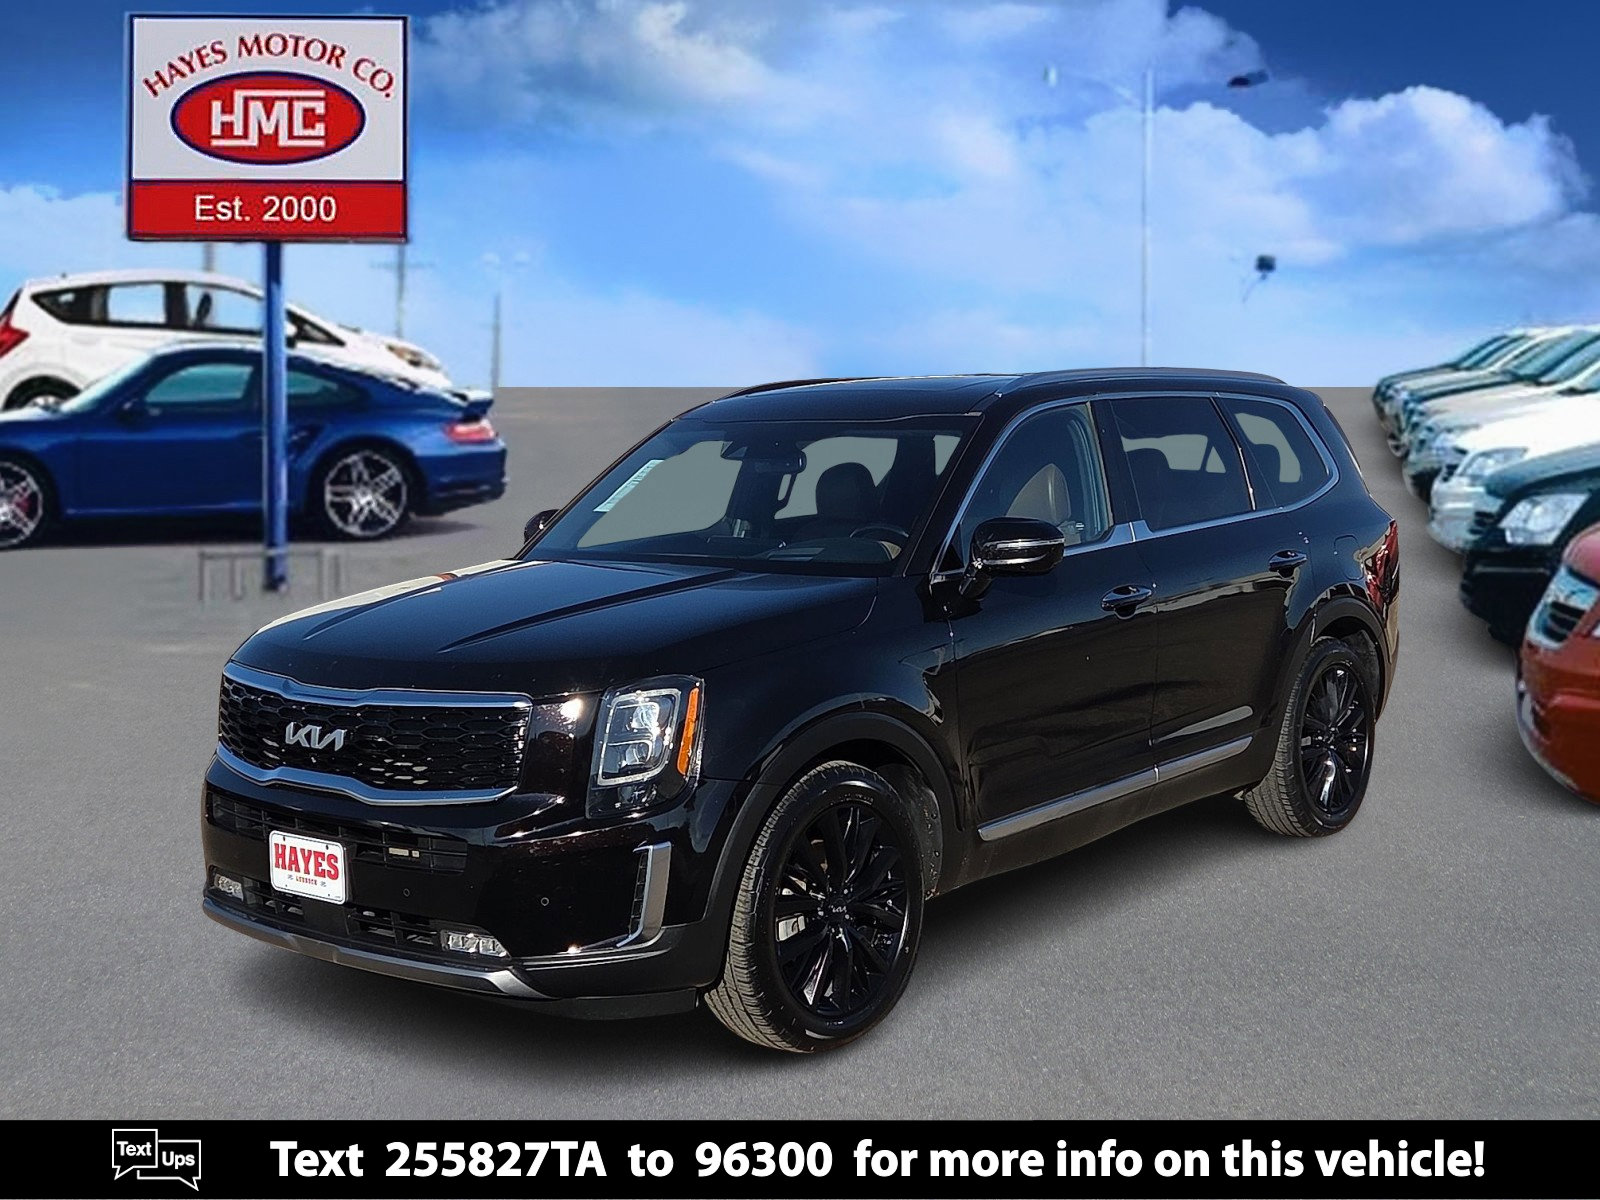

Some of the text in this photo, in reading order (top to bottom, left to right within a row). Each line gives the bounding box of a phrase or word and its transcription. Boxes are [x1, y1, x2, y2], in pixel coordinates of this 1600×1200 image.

[142, 32, 394, 99] HAYES MOTOR CO.
[210, 89, 326, 147] HMC
[194, 194, 337, 222] Est. 2000
[284, 721, 348, 751] KIA
[273, 842, 340, 881] HAYES
